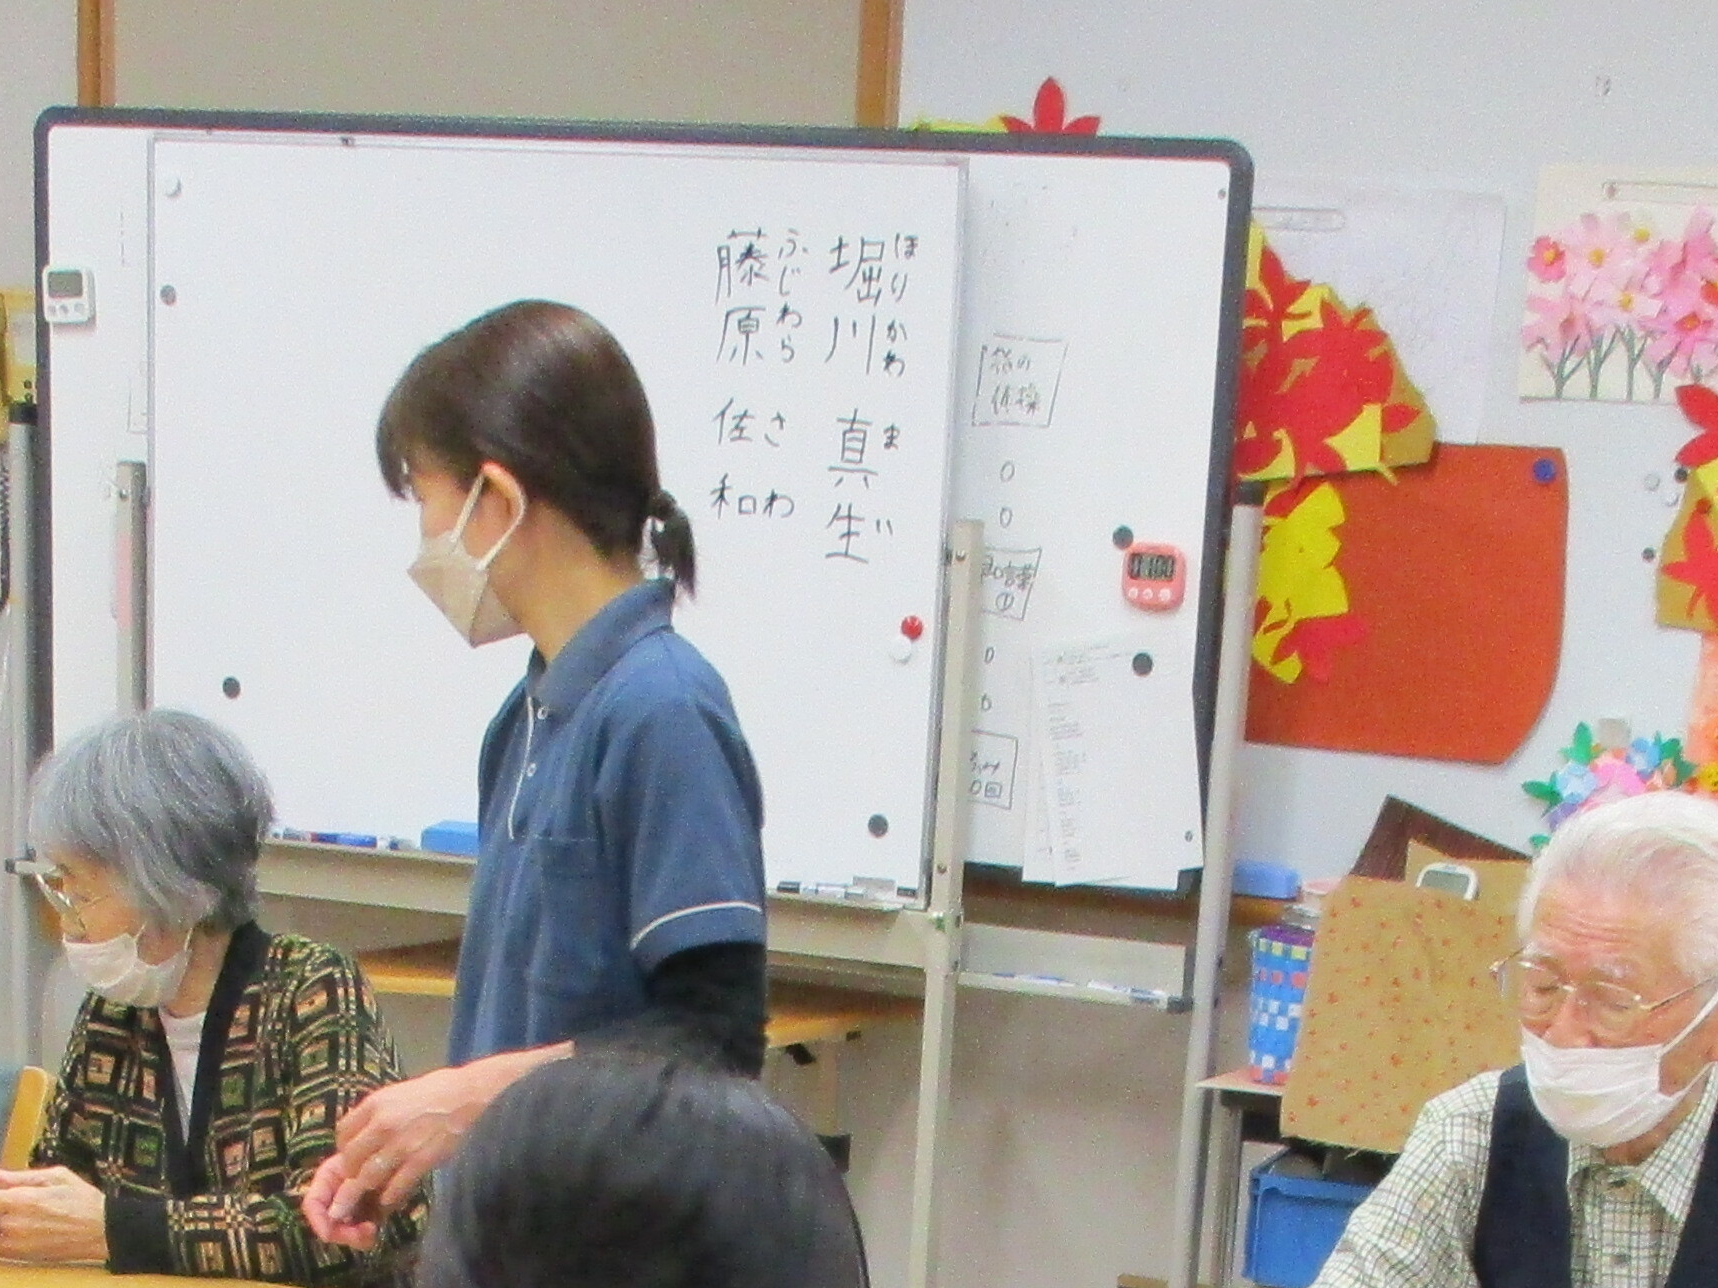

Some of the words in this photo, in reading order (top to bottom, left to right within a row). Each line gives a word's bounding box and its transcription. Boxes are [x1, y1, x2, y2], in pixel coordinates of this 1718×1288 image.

[715, 228, 768, 365] 藤原
[826, 236, 885, 374] 堀川
[711, 397, 757, 519] 佐和
[826, 409, 878, 564] 真生
